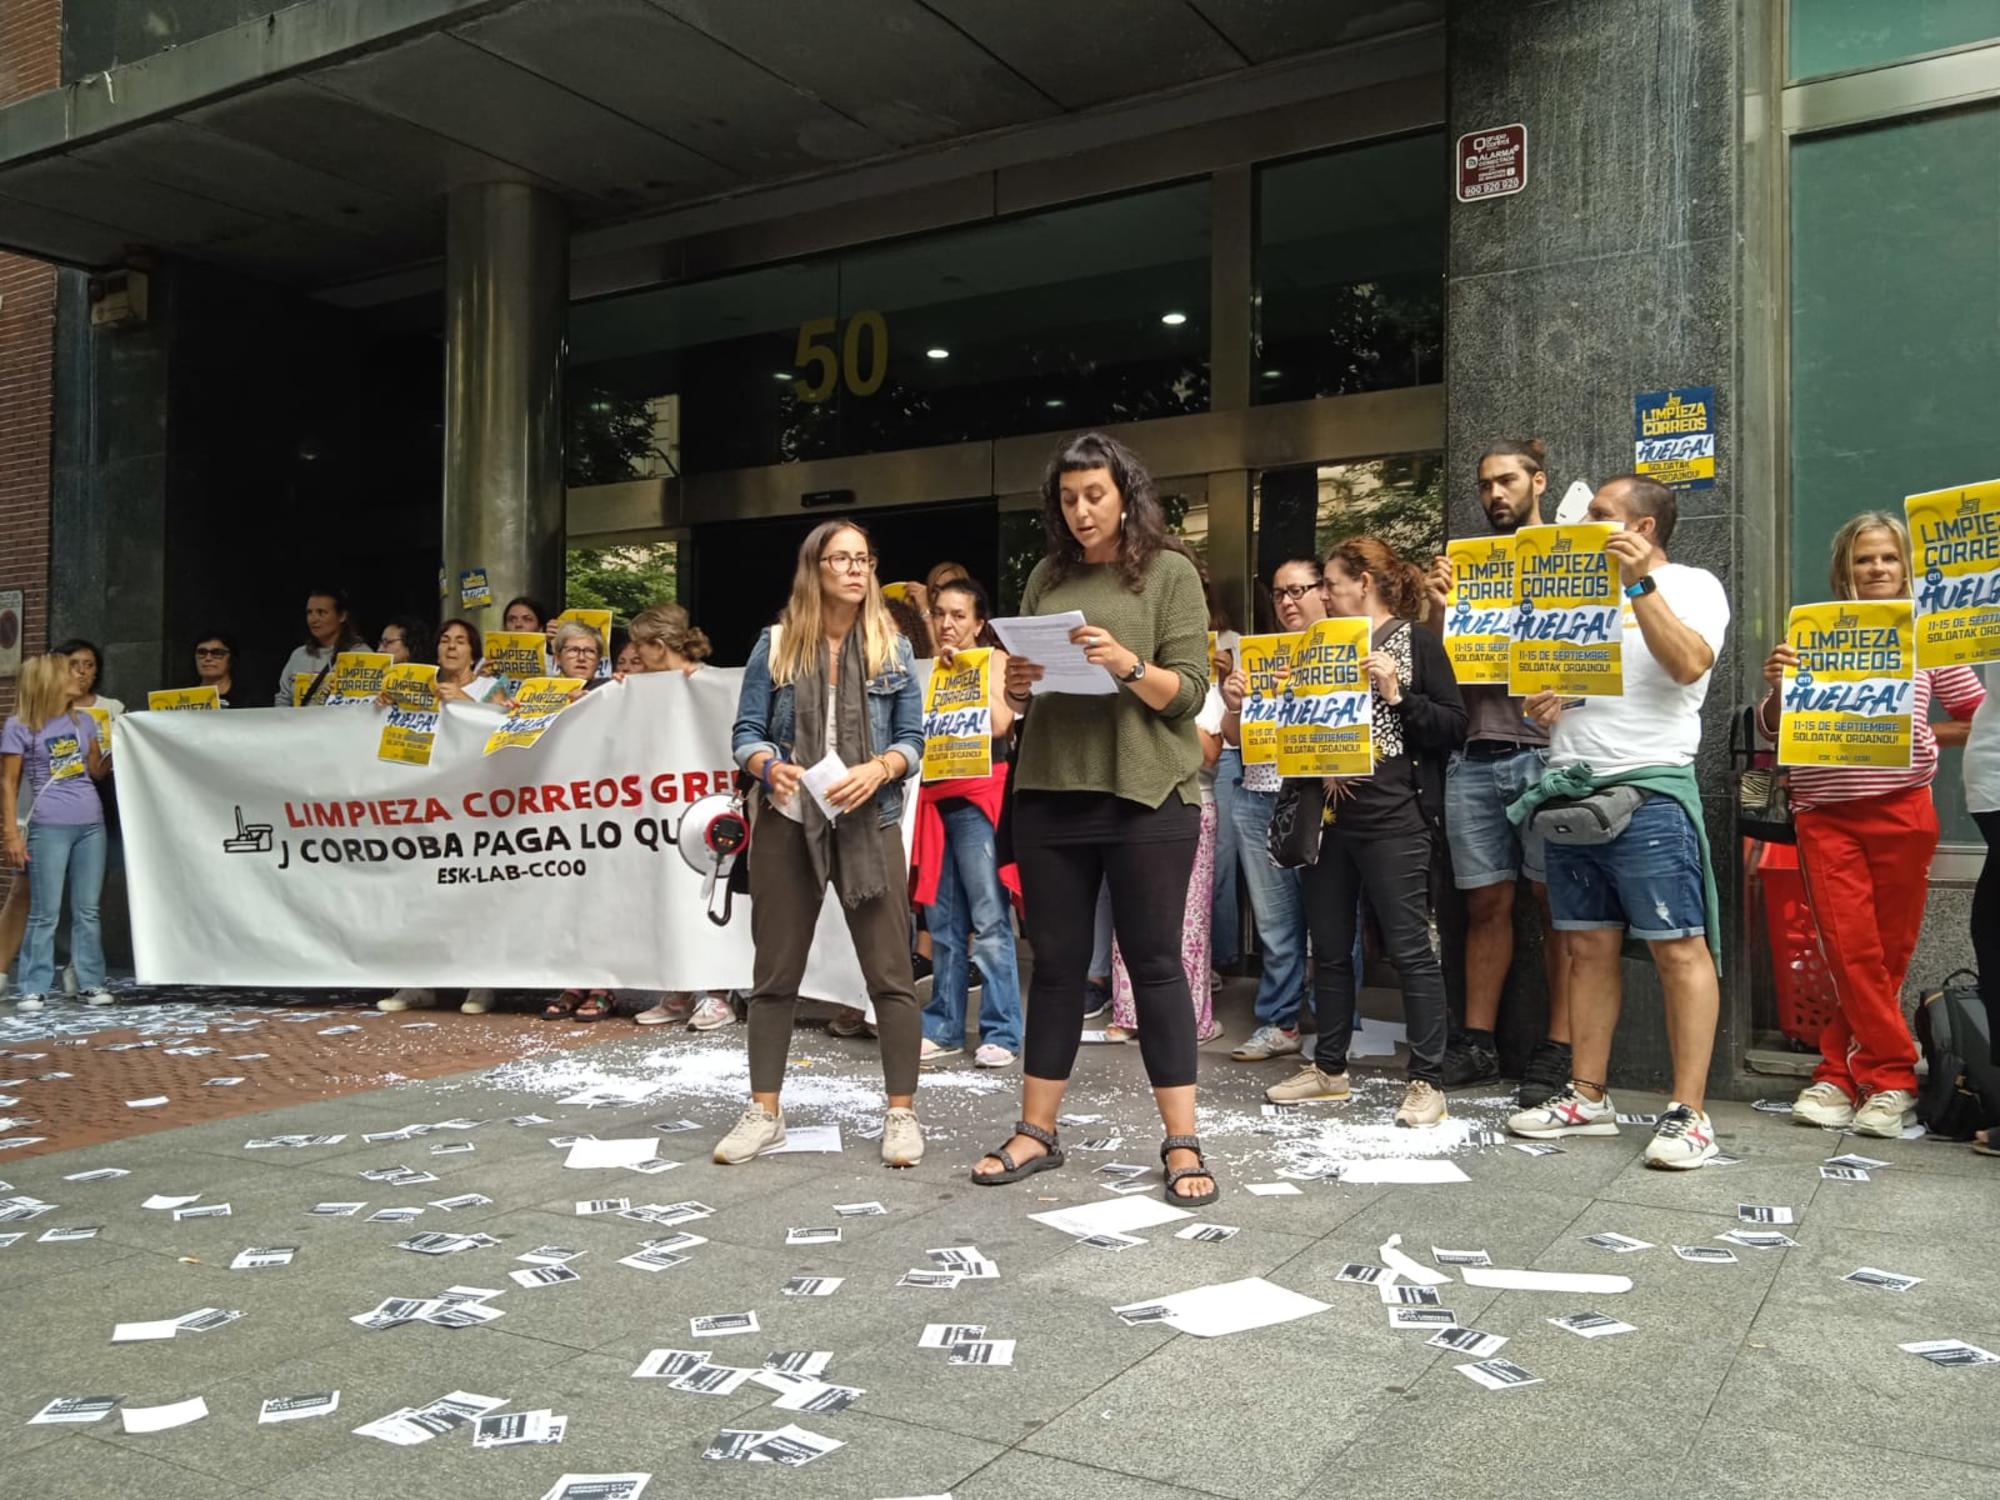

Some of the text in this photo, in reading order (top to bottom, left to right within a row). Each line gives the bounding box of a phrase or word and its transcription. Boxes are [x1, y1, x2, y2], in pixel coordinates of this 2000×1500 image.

[1479, 148, 1515, 161] ALARMA
[794, 309, 888, 403] 50
[1642, 402, 1707, 424] LIMPIEZA
[1643, 417, 1707, 436] CORREOS
[1638, 436, 1711, 461] HUELGA!
[1521, 552, 1609, 575] LIMPIEZA
[1521, 576, 1609, 598] CORREOS
[1928, 572, 1941, 581] en
[1521, 603, 1533, 611] en
[1513, 608, 1617, 645] HUELGA!
[1929, 619, 1950, 631] 11-15
[1953, 617, 1966, 627] DE
[1797, 627, 1900, 651] LIMPIEZA
[1927, 629, 1977, 643] SOLDATAK
[490, 648, 538, 661] LIMPIEZA
[1290, 644, 1358, 669] LIMPIEZA
[1455, 643, 1472, 651] 11-15
[1475, 643, 1486, 652] DE
[1455, 653, 1496, 662] SOLDATAK
[1519, 650, 1610, 661] 11-15 DE SEPTIEMBRE
[1519, 662, 1561, 672] SOLDATAK
[1799, 651, 1900, 672] CORREOS
[337, 667, 383, 679] LIMPIEZA
[935, 667, 980, 691] LIMPIEZA
[1285, 665, 1359, 688] CORREOS
[1798, 676, 1811, 684] en
[932, 687, 980, 708] CORREOS
[1785, 682, 1908, 714] HUELGA!
[1278, 694, 1367, 728] HUELGA!
[923, 709, 986, 739] HUELGA!
[1794, 721, 1899, 733] 11-15 DE SEPTIEMBRE
[1792, 732, 1843, 743] SOLDATAK
[285, 770, 740, 828] LIMPIEZA CORREOS GRE
[278, 840, 290, 870] J
[300, 831, 463, 863] CORDOBA
[473, 825, 571, 857] PAGA
[580, 820, 622, 850] LO
